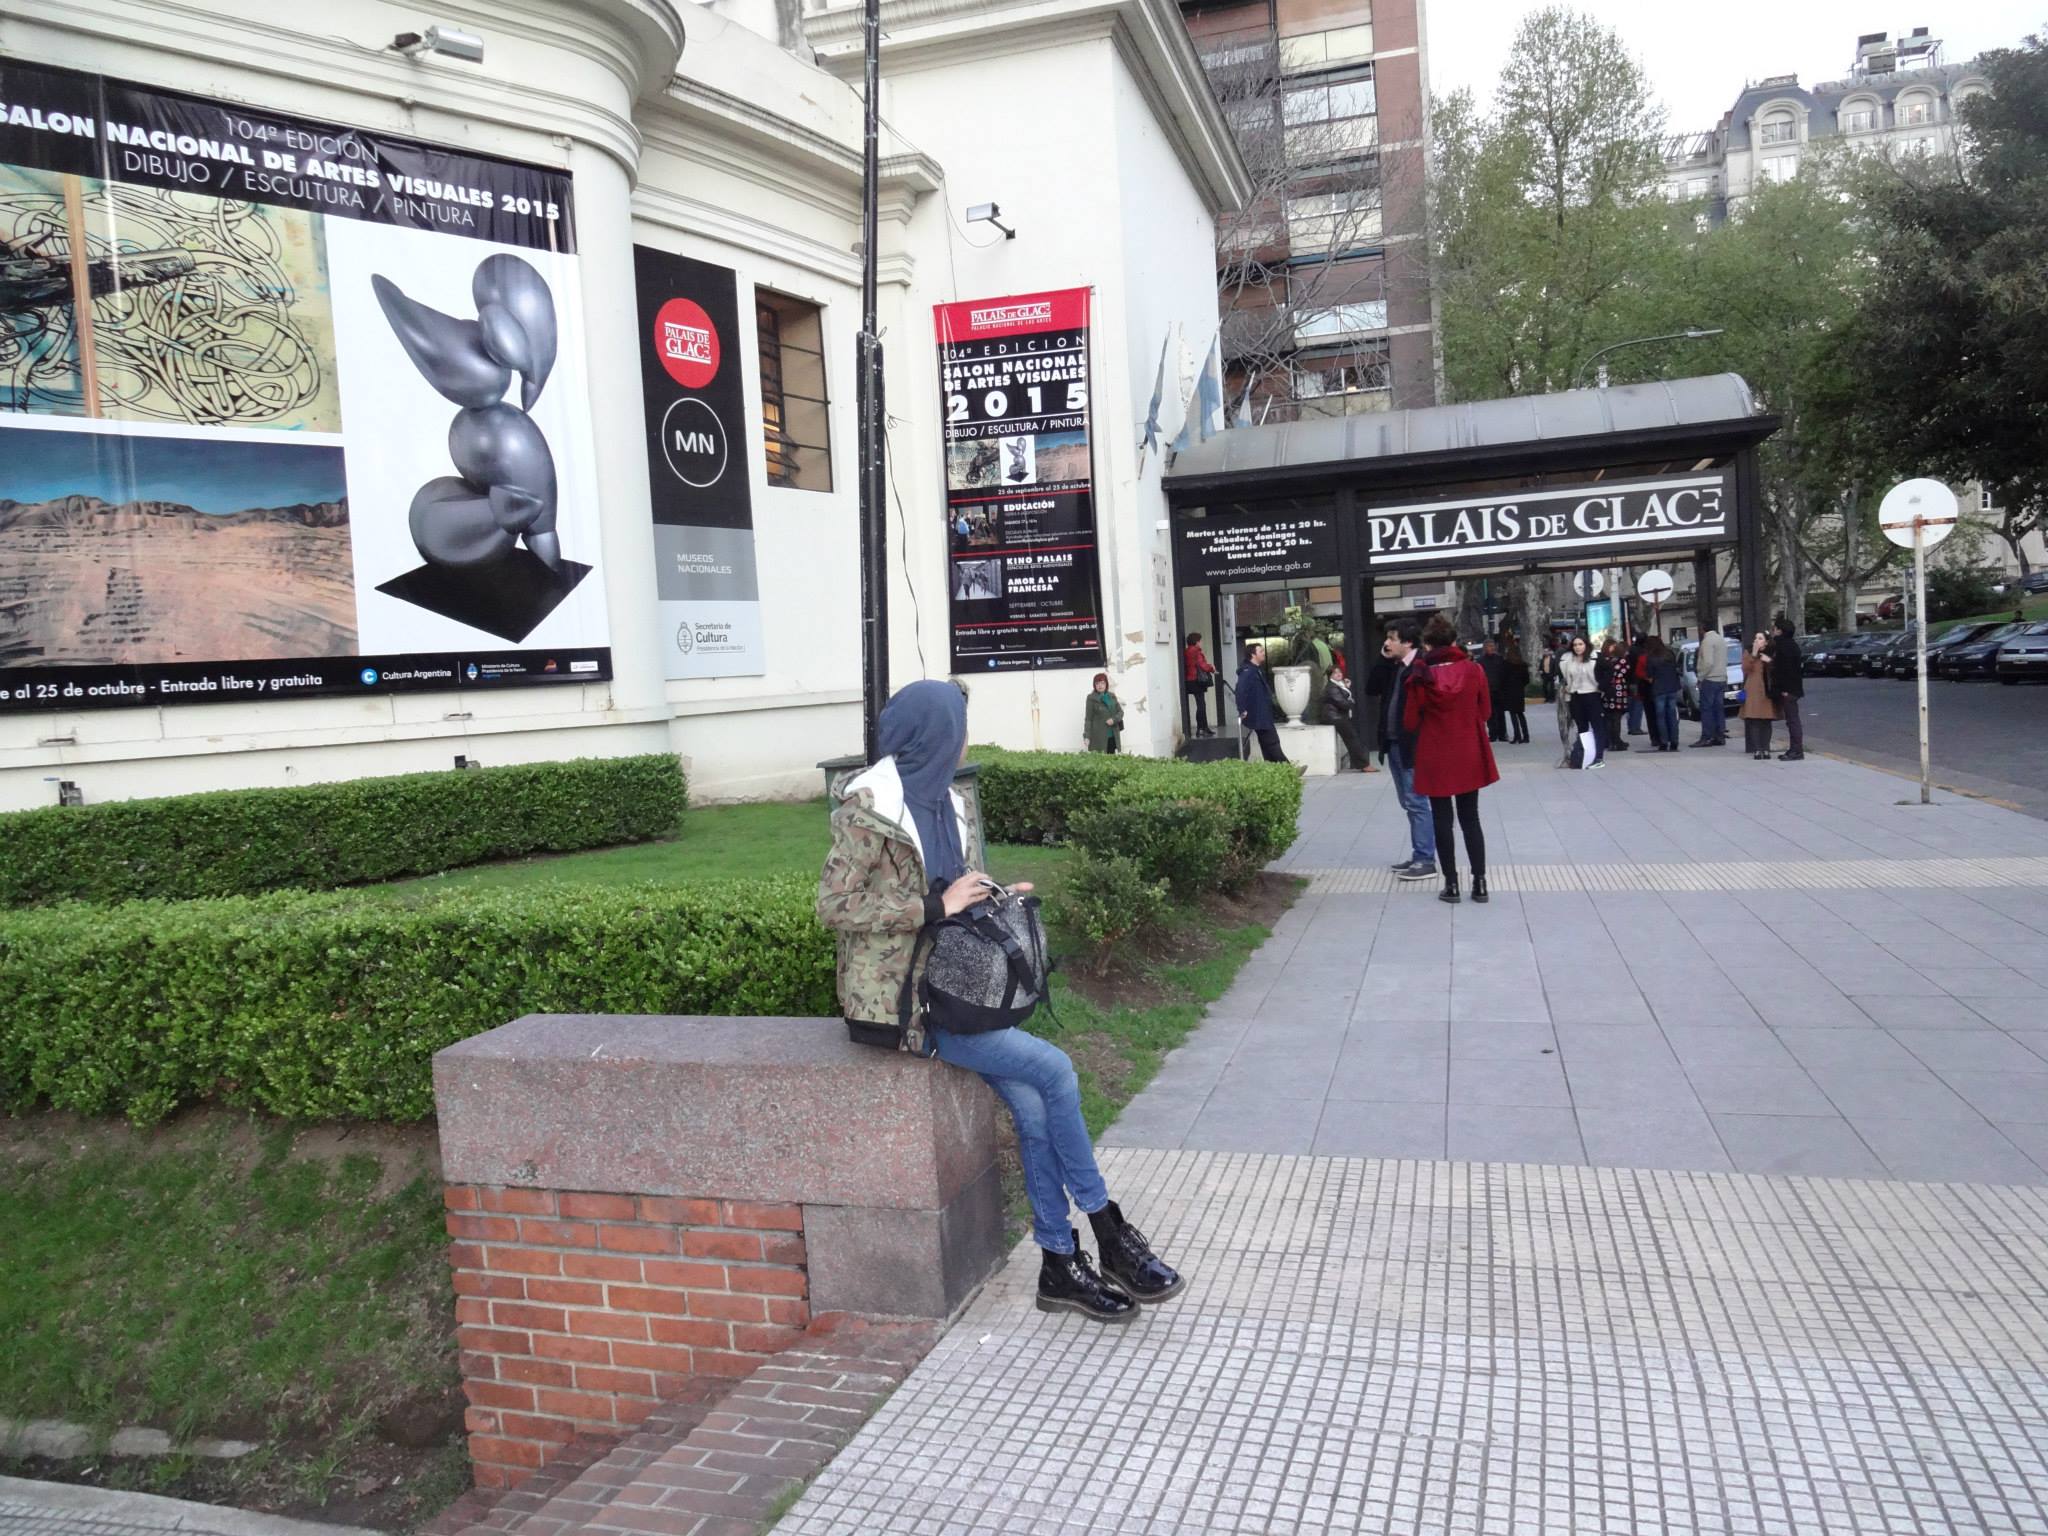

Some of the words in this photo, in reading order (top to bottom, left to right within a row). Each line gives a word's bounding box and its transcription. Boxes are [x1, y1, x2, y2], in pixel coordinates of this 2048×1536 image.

[285, 129, 379, 164] EDICIÓN
[106, 121, 255, 166] NACIONAL
[262, 150, 297, 173] DE
[306, 158, 380, 188] ARTES
[387, 173, 494, 208] VISUALES
[501, 194, 560, 220] 2015
[125, 151, 211, 183] DIBUJO
[244, 171, 366, 209] ESCULTURA
[393, 197, 475, 227] PINTURA
[971, 310, 1006, 323] PALAIS
[665, 326, 696, 343] PALAIS
[697, 333, 710, 345] DE
[666, 337, 711, 360] GLACE
[944, 363, 995, 380] SALON
[1002, 354, 1086, 373] NACIONAL
[944, 380, 961, 391] DE
[967, 375, 1011, 389] ARTES
[1016, 367, 1086, 384] VISUALES
[947, 382, 1088, 421] 2015
[946, 428, 978, 439] DIBUJO
[988, 422, 1039, 435] ESCULTURA
[1050, 417, 1089, 430] PINTURA
[675, 430, 715, 455] MN
[1004, 500, 1055, 512] EDUCACIÓN
[1368, 504, 1520, 552] PALAIS
[1528, 514, 1568, 538] DE
[1573, 487, 1725, 534] GLACE
[1187, 530, 1216, 539] Martes
[1227, 527, 1258, 535] viernes
[1299, 521, 1311, 529] 20
[1255, 532, 1296, 542] domingos
[1247, 542, 1258, 550] de
[1261, 541, 1273, 549] 10
[1285, 539, 1297, 547] 20
[677, 554, 714, 563] MUSEOS
[1007, 557, 1033, 565] KINO
[1037, 554, 1073, 564] PALAIS
[1228, 552, 1251, 560] Lunes
[1254, 549, 1287, 558] cerrado
[678, 564, 732, 575] NACIONALES
[1206, 561, 1312, 577] www.palaisdeglace.gob.ar
[1008, 577, 1035, 586] AMOR
[1008, 584, 1054, 593] FRANCESA
[725, 622, 732, 630] de
[978, 628, 991, 636] libre
[696, 632, 728, 643] Cultura
[382, 671, 413, 681] Cultura
[414, 669, 452, 681] Argentina
[15, 684, 30, 699] al
[36, 685, 58, 698] 25
[64, 682, 83, 697] de
[88, 681, 145, 697] octubre
[161, 678, 217, 694] Entrada
[222, 676, 254, 691] libre
[257, 679, 267, 693] y
[270, 674, 323, 691] gratuita
